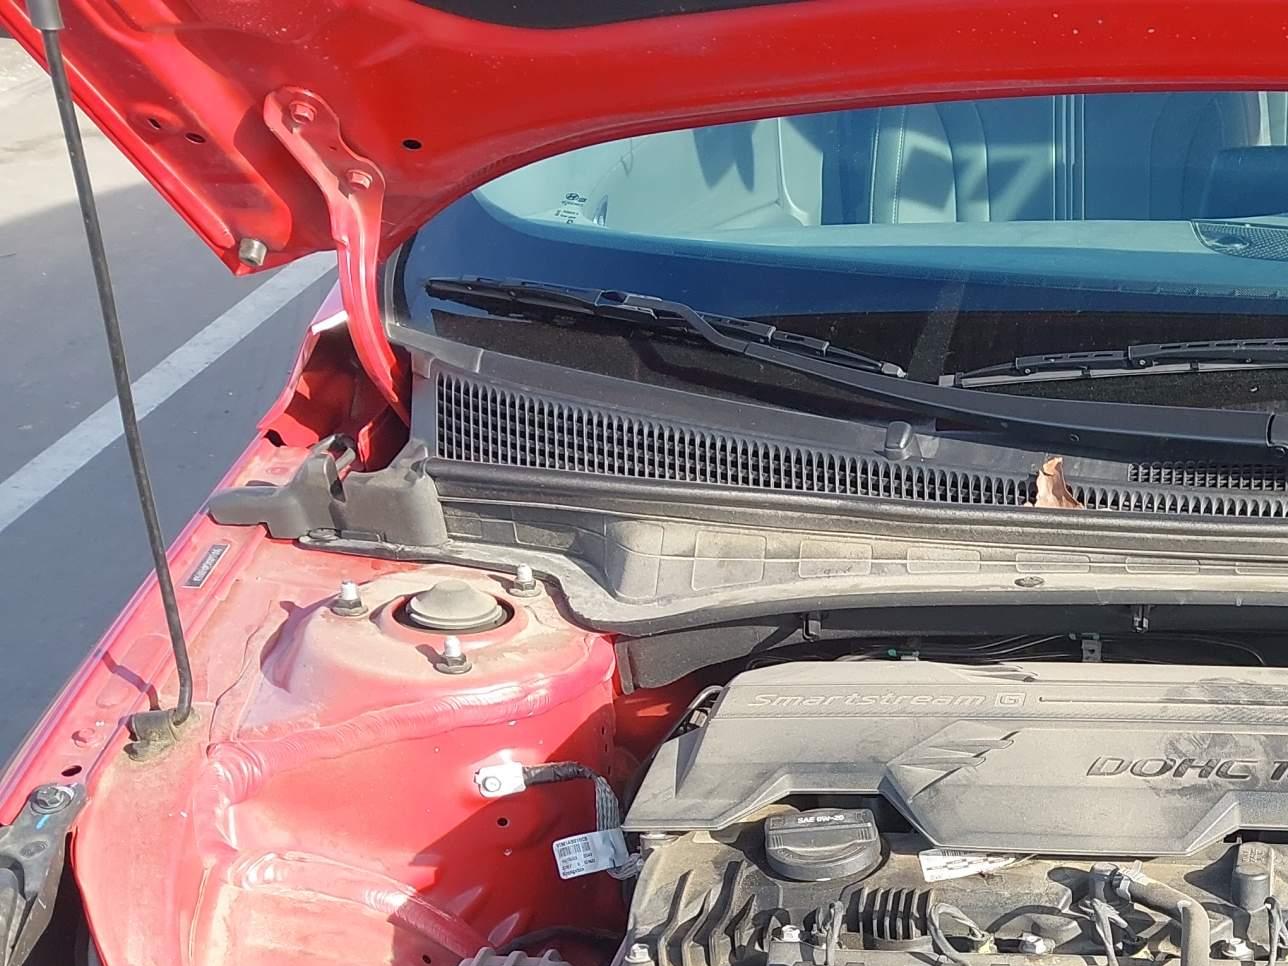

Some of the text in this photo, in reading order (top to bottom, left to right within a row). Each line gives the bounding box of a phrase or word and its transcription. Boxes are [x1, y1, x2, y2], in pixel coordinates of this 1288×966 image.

[749, 692, 986, 706] Smartstream
[1086, 757, 1258, 779] DOHC
[797, 816, 815, 824] SAE
